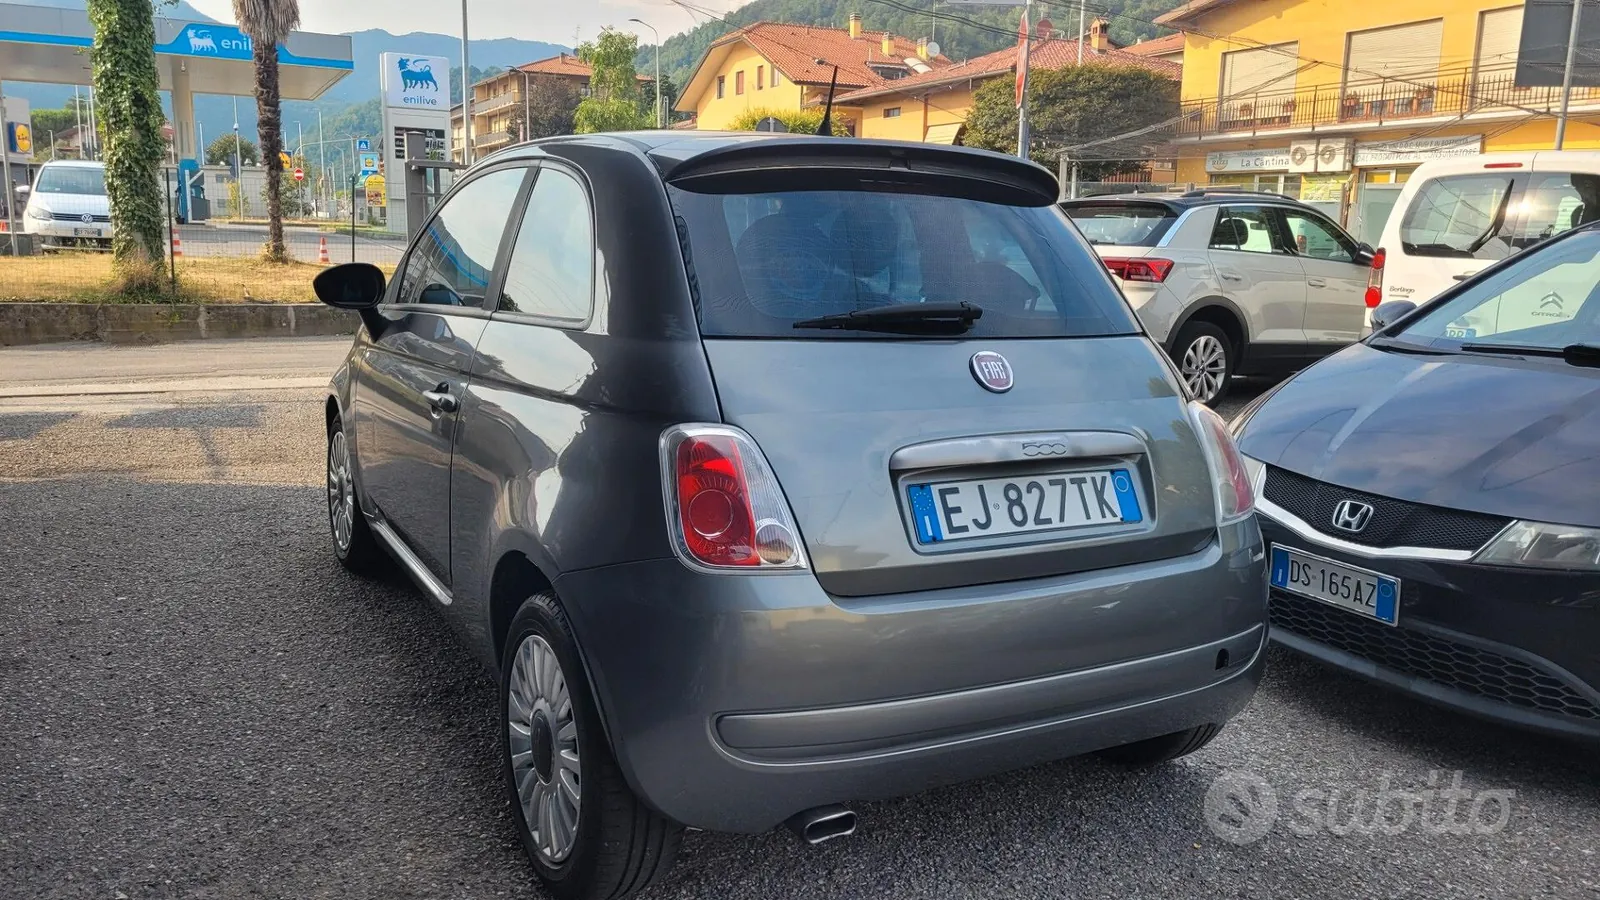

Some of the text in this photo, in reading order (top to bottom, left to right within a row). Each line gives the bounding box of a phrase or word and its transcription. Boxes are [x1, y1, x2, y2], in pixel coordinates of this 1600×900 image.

[221, 36, 252, 51] enil
[403, 95, 437, 106] enilive
[1241, 156, 1290, 167] La Cantina
[1389, 285, 1416, 295] Berlingo
[980, 361, 1007, 380] FIAT
[1021, 441, 1067, 457] 500
[938, 475, 1118, 534] EJ 827TK
[1290, 560, 1377, 609] DS 165AZ
